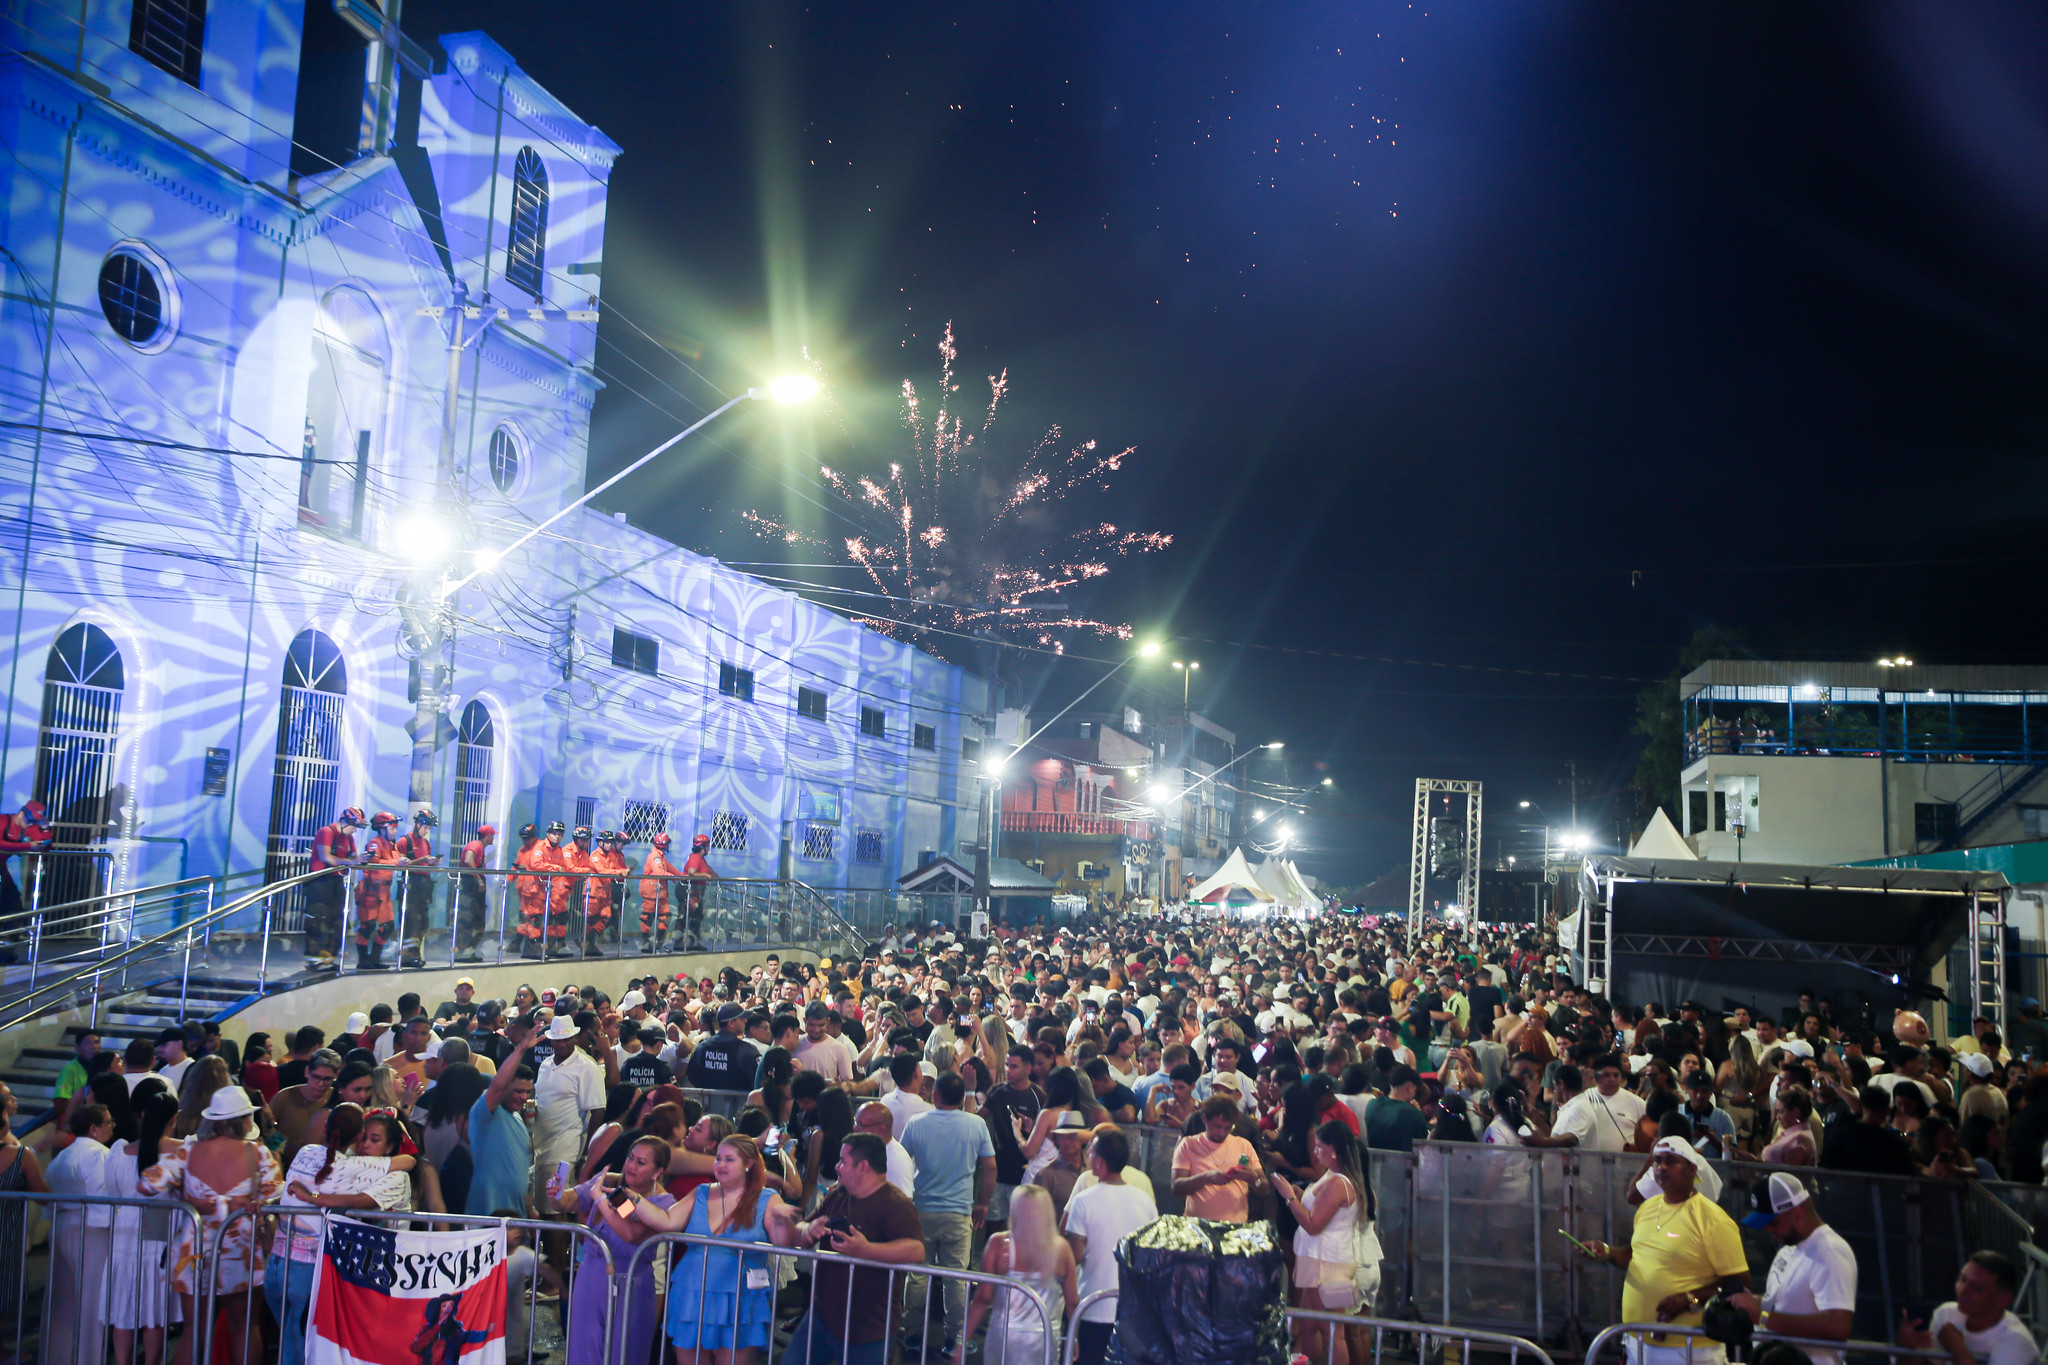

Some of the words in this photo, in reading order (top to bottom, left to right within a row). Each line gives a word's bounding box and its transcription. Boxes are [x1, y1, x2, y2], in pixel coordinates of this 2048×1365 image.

[705, 1050, 728, 1061] POLÍCIA
[630, 1066, 655, 1076] POLÍCIA
[705, 1060, 728, 1071] MILITAR
